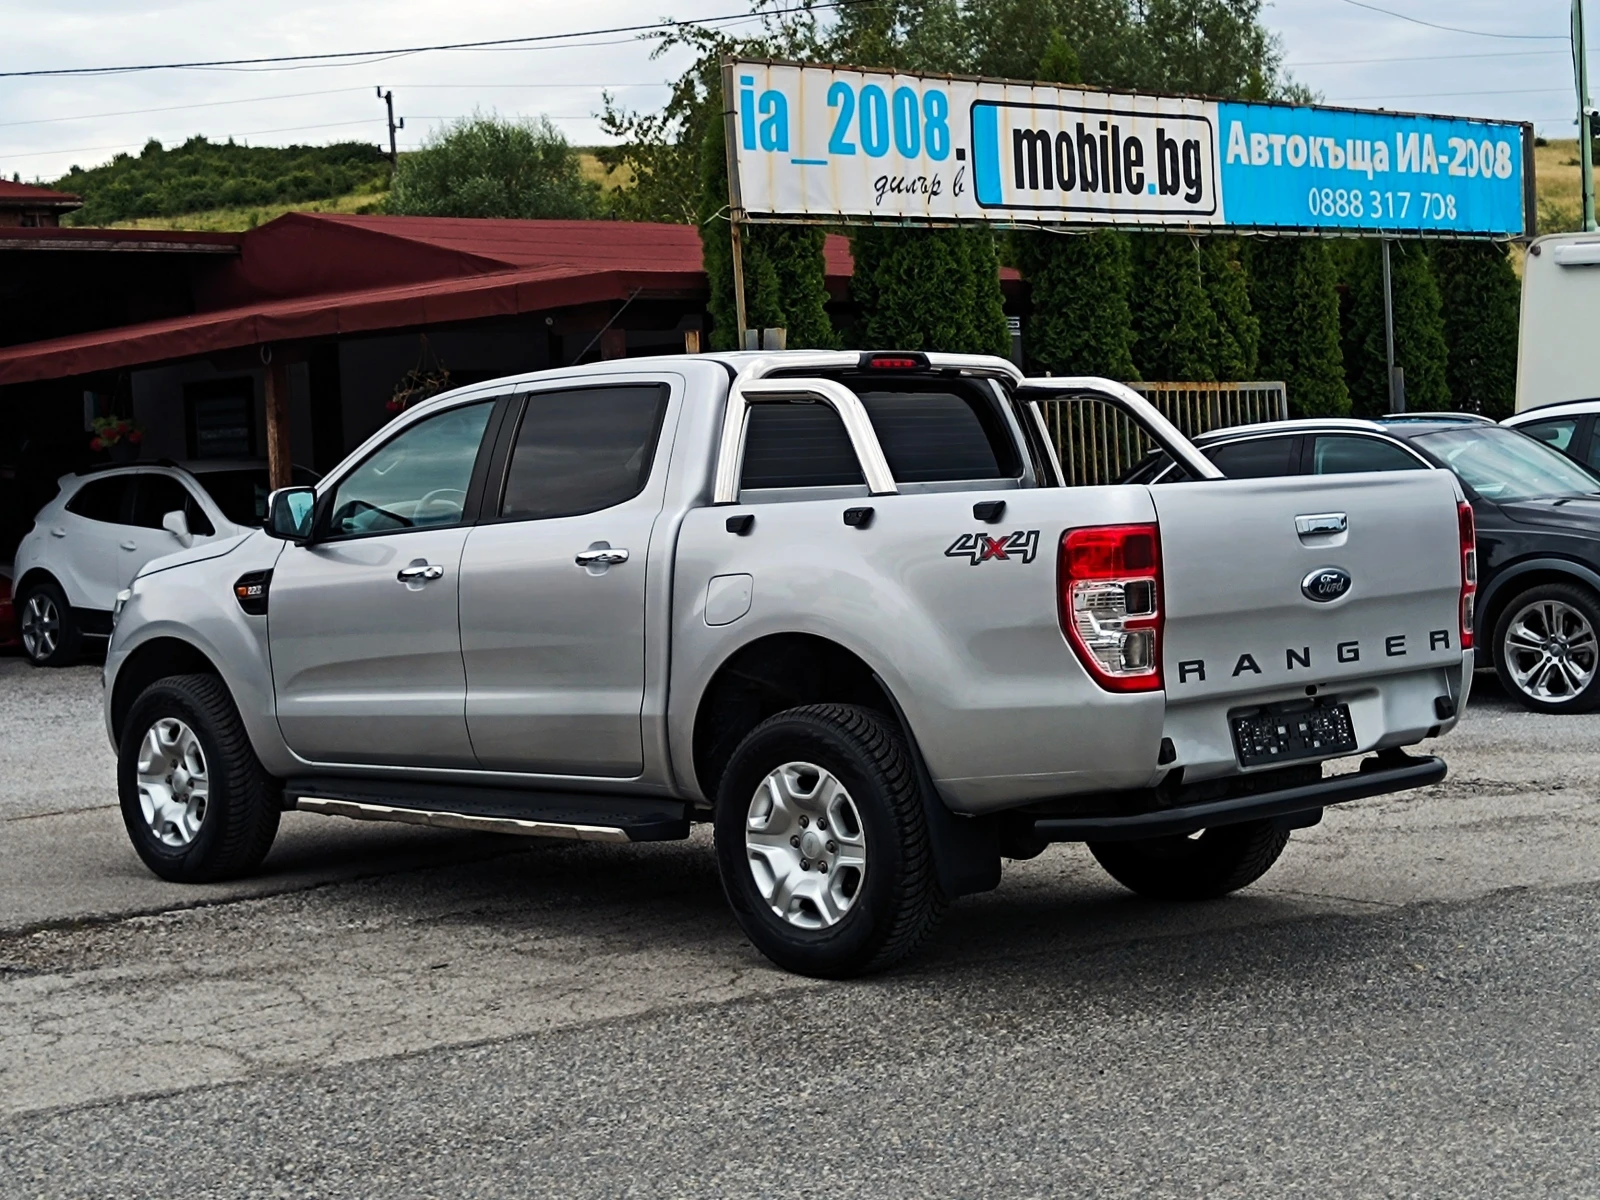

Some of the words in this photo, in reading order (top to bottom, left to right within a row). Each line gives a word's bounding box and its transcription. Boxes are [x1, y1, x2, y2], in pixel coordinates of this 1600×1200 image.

[1012, 121, 1201, 204] mobile.bg
[1226, 120, 1389, 180] Автокъща
[1396, 131, 1513, 180] ИА-2008
[873, 172, 942, 206] дилър
[952, 164, 965, 197] в
[1308, 187, 1364, 218] 0888
[1369, 190, 1411, 219] 317
[1420, 192, 1457, 221] 708
[1317, 573, 1345, 593] Ford
[1178, 629, 1451, 684] RANGER
